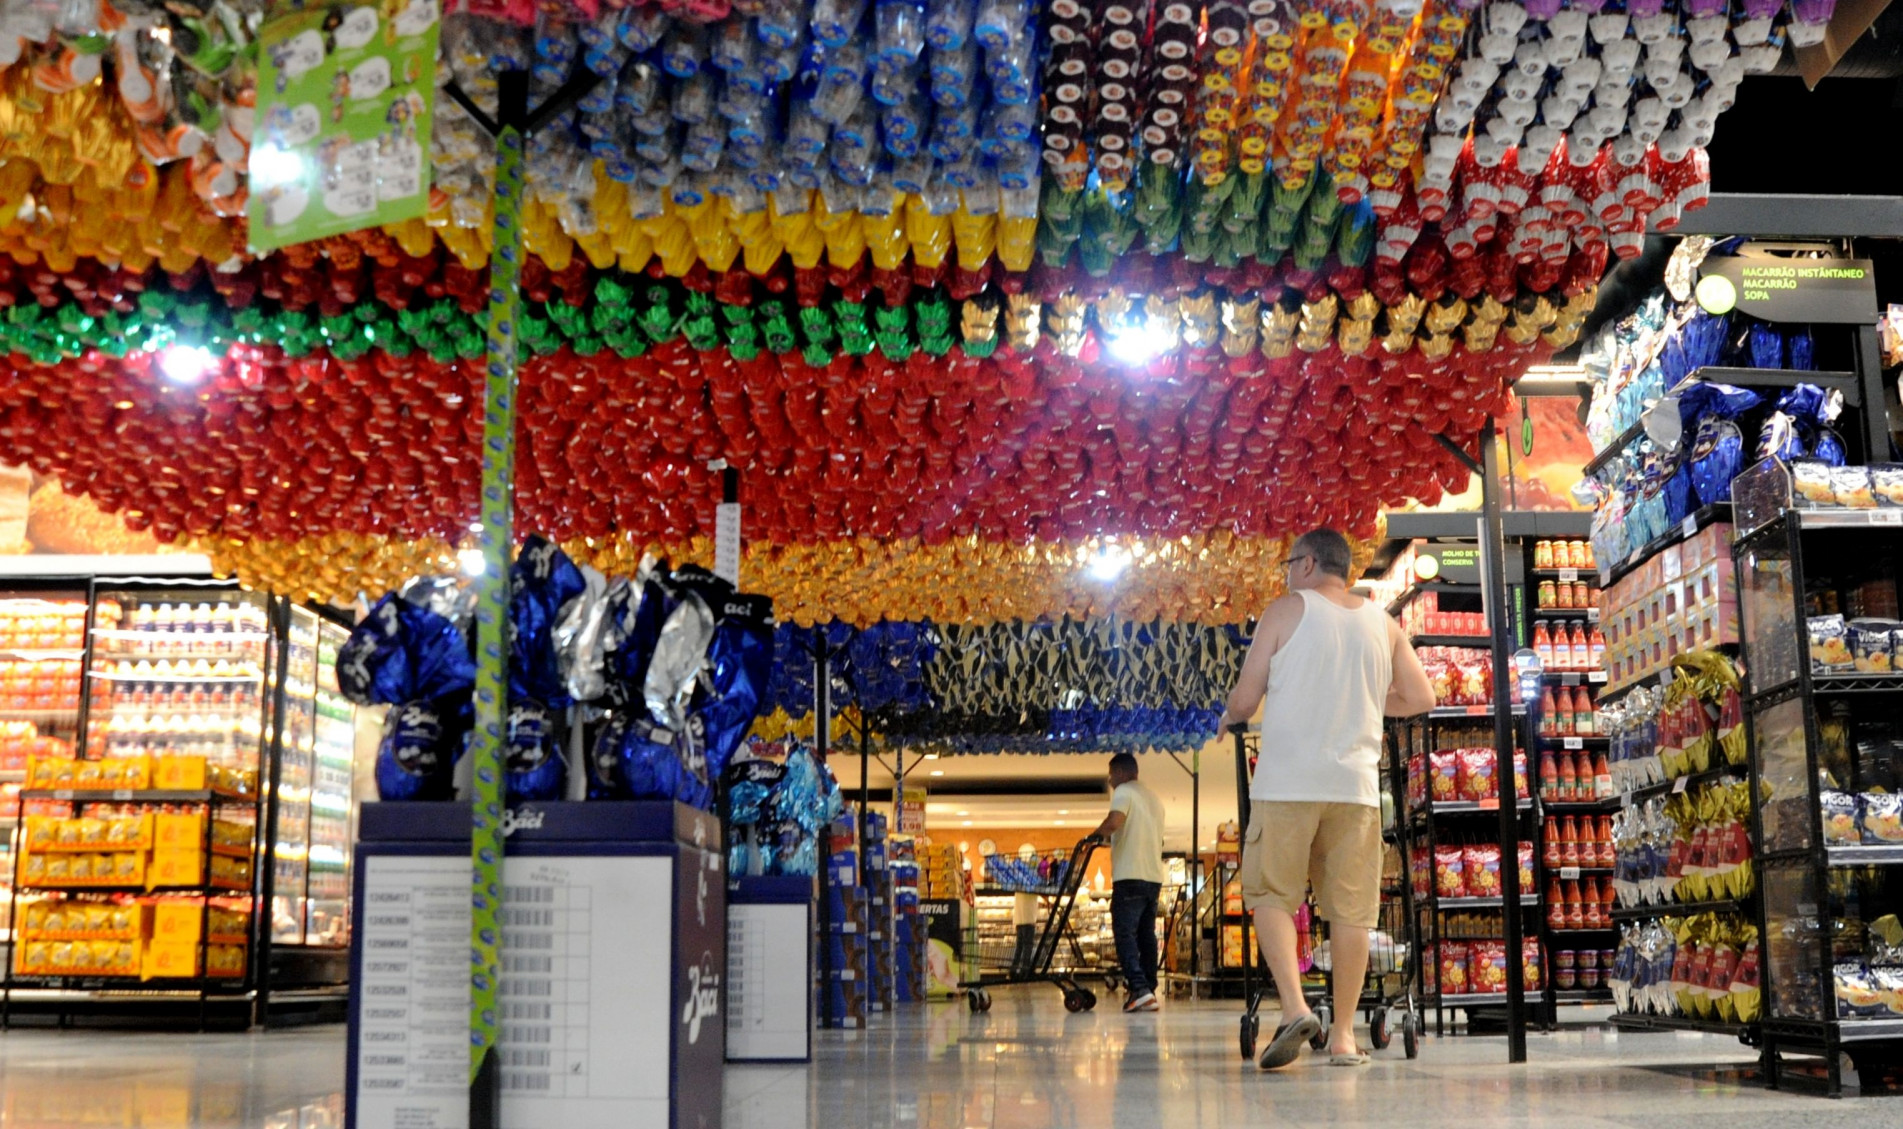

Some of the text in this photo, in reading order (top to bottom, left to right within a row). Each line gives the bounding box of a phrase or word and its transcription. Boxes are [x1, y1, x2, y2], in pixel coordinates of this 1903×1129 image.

[1742, 265, 1796, 278] MACARRÃO
[1743, 277, 1797, 289] MACARRÃO
[1744, 290, 1770, 300] SOPA
[1442, 550, 1464, 558] MOLHO
[1465, 550, 1474, 558] DE
[1442, 558, 1474, 566] CONSERVA
[499, 809, 545, 837] Baci
[919, 903, 949, 915] ERTAS
